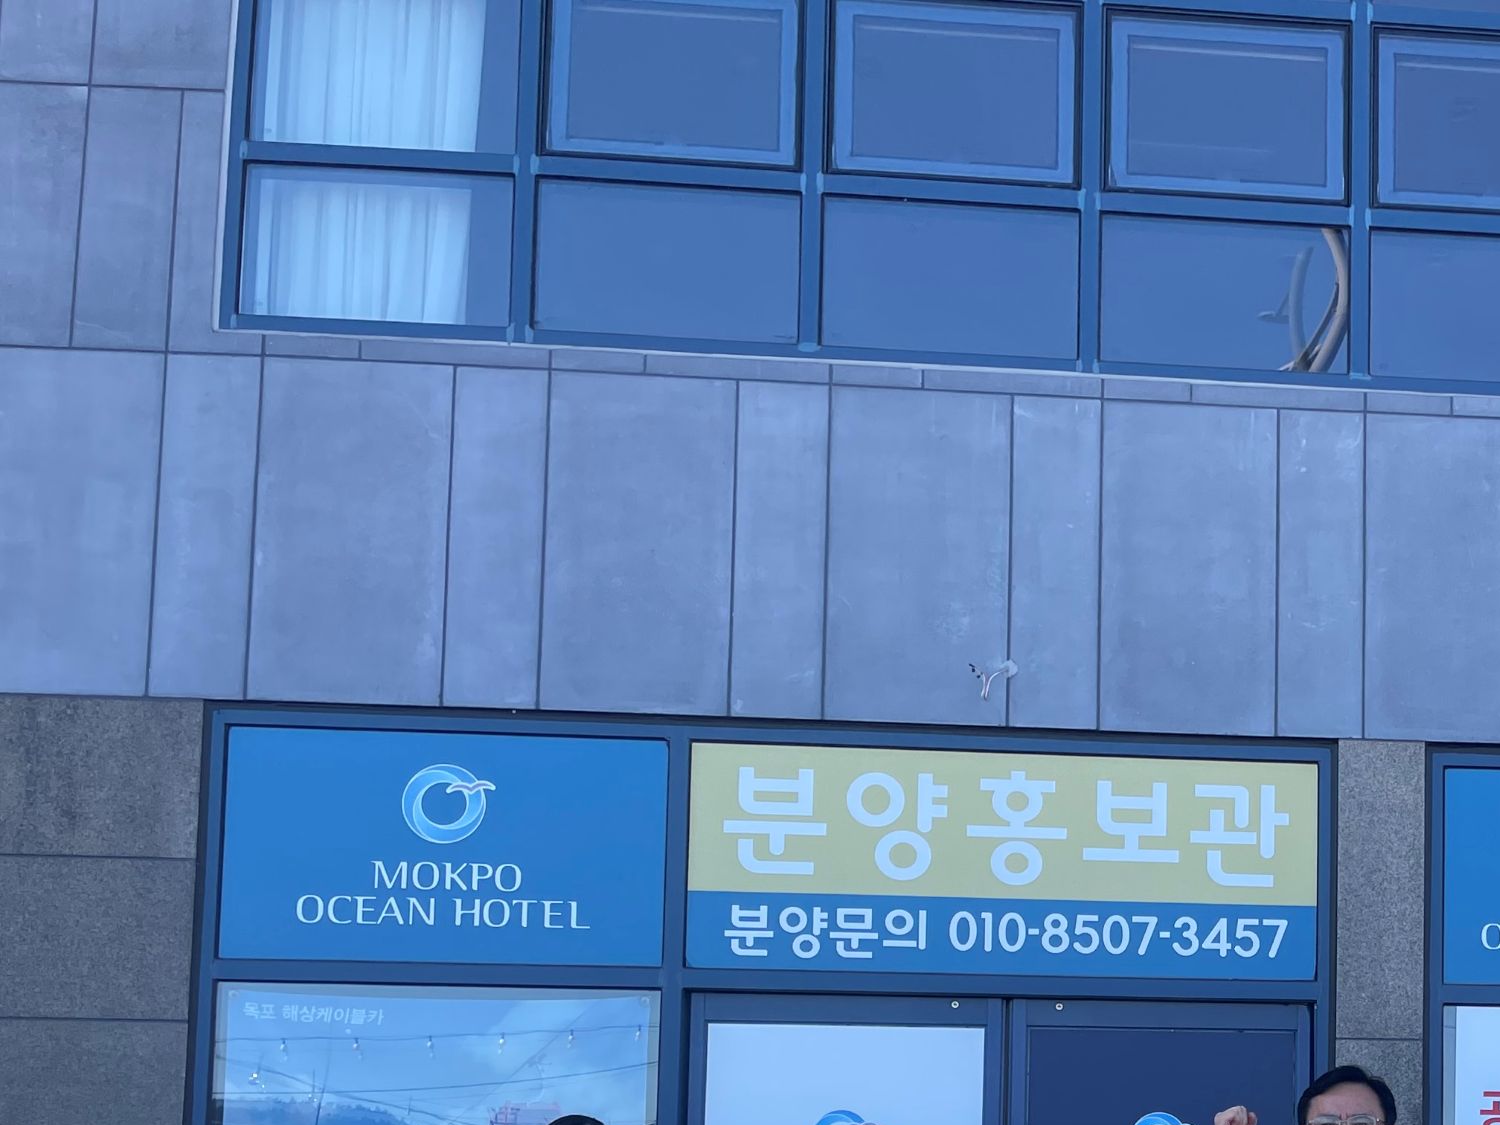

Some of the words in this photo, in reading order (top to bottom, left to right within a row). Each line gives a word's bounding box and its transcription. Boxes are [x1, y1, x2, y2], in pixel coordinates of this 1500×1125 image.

[722, 766, 1291, 888] 분양홍보관
[372, 860, 523, 892] MOKPO
[295, 894, 437, 927] OCEAN
[453, 898, 592, 930] HOTEL
[724, 904, 927, 959] 분양문의
[948, 910, 1289, 959] 010-8507-3457
[242, 1001, 277, 1020] 목포
